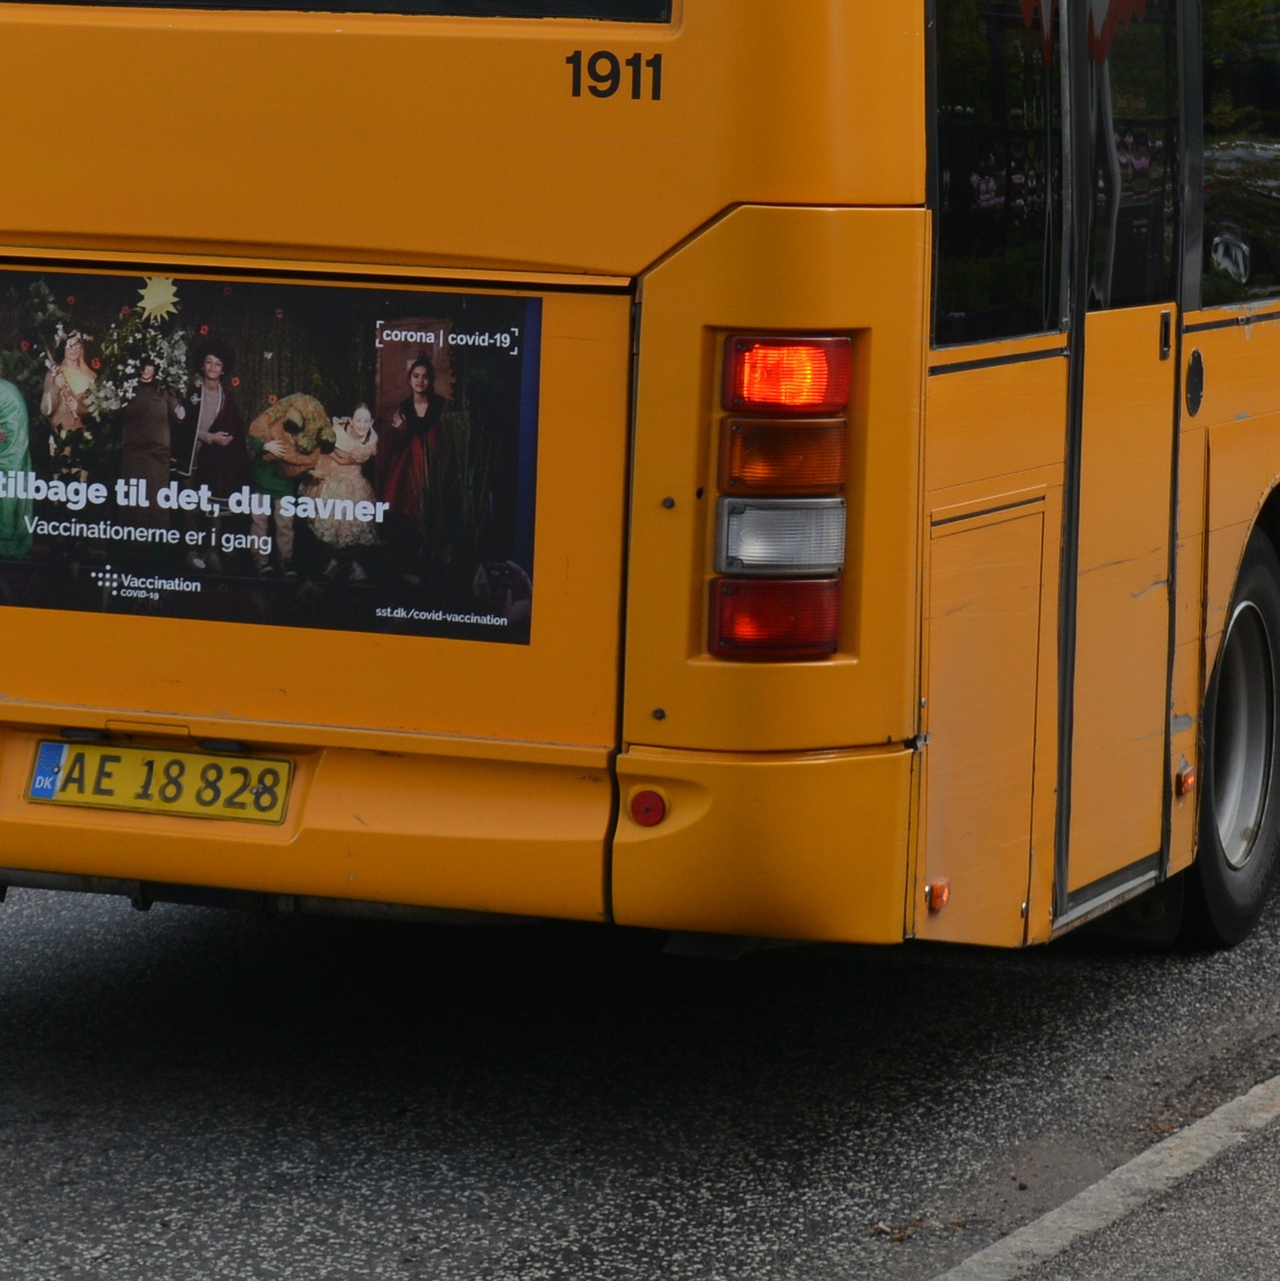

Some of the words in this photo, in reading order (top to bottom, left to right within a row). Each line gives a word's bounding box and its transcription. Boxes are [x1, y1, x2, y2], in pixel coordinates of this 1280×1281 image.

[565, 50, 662, 101] 1911
[382, 329, 435, 343] corona
[448, 332, 510, 347] covid-19
[115, 478, 150, 507] til
[156, 481, 220, 517] det,
[228, 485, 272, 516] du
[280, 494, 390, 523] savner
[24, 515, 180, 544] Vaccinationerne
[185, 530, 206, 545] er
[211, 527, 216, 546] i
[221, 532, 272, 555] gang
[120, 589, 159, 600] COVID-19
[121, 574, 201, 592] Vaccination
[376, 607, 508, 626] sst.dk/covid-vaccination
[34, 776, 52, 789] DK
[59, 752, 121, 796] AE
[134, 759, 186, 803] 18
[195, 763, 281, 812] 828
